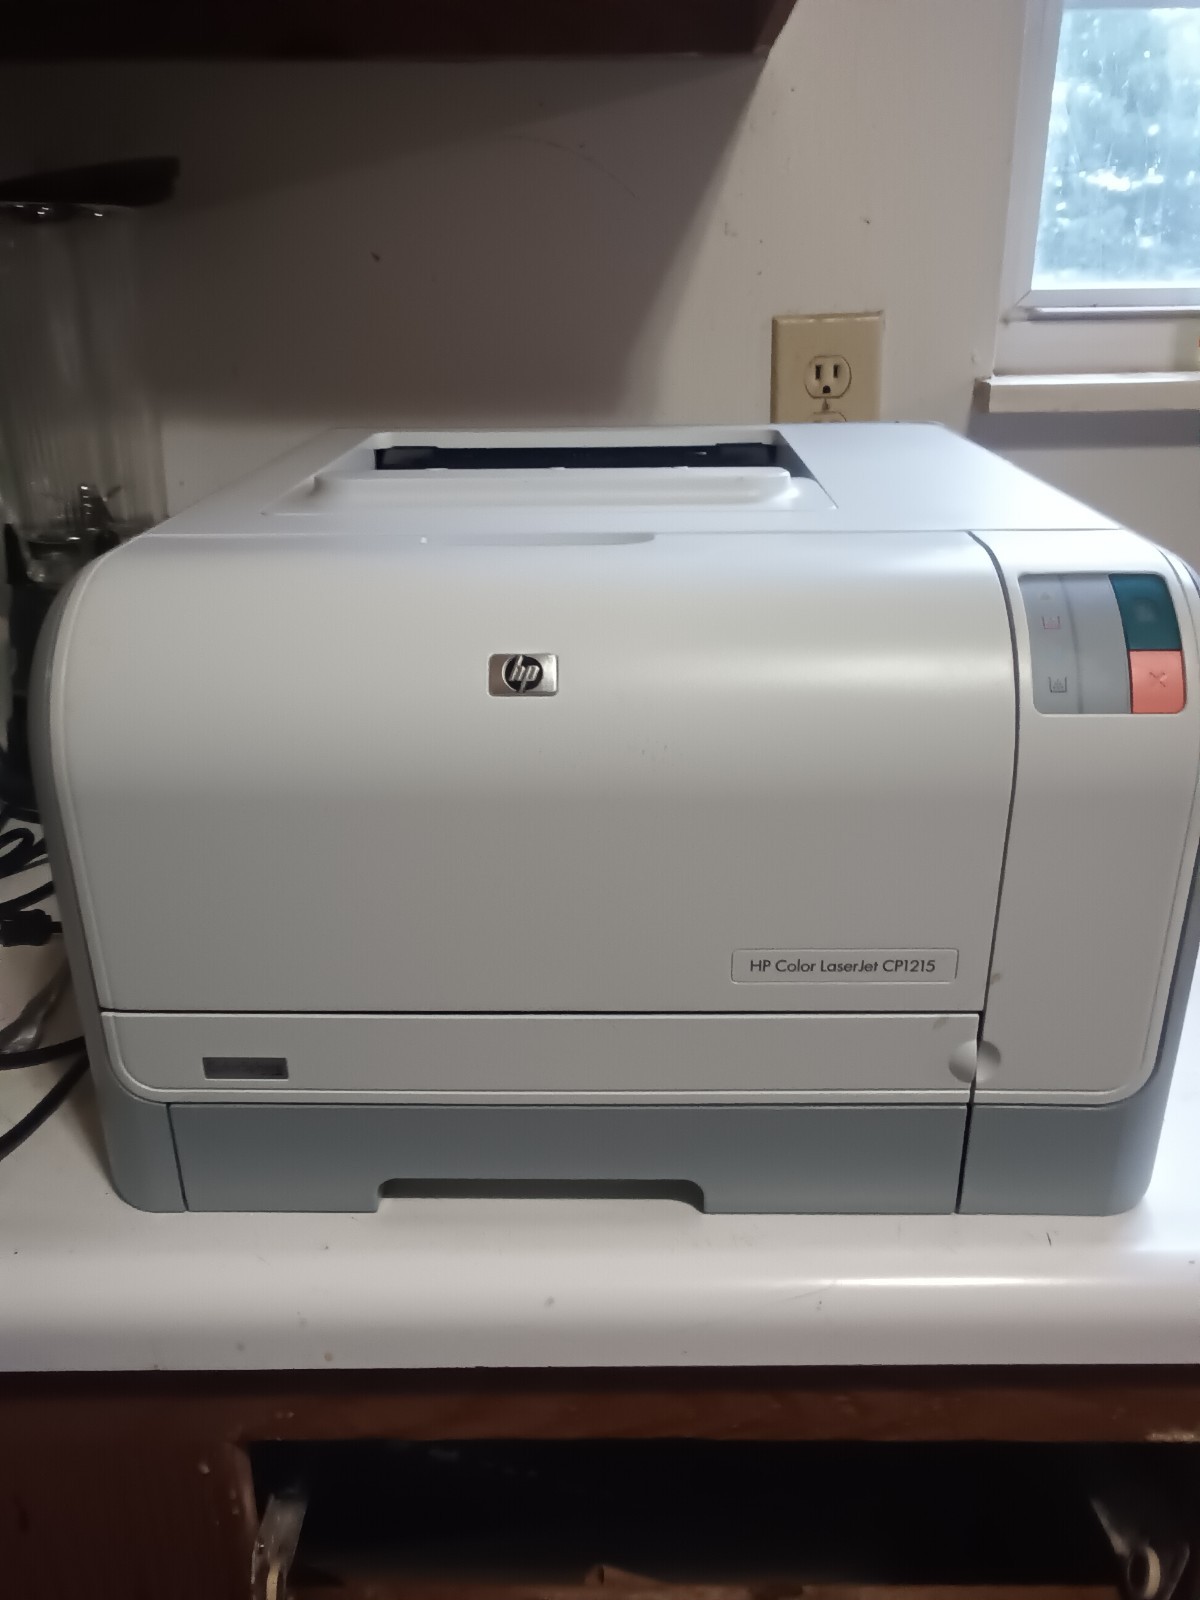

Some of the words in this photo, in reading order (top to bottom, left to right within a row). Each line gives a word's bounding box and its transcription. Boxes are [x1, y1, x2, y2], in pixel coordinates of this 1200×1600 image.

[507, 654, 541, 693] hp
[749, 959, 771, 973] HP
[775, 958, 816, 973] Color
[820, 959, 878, 973] LaserJet
[882, 959, 936, 973] CP1215
